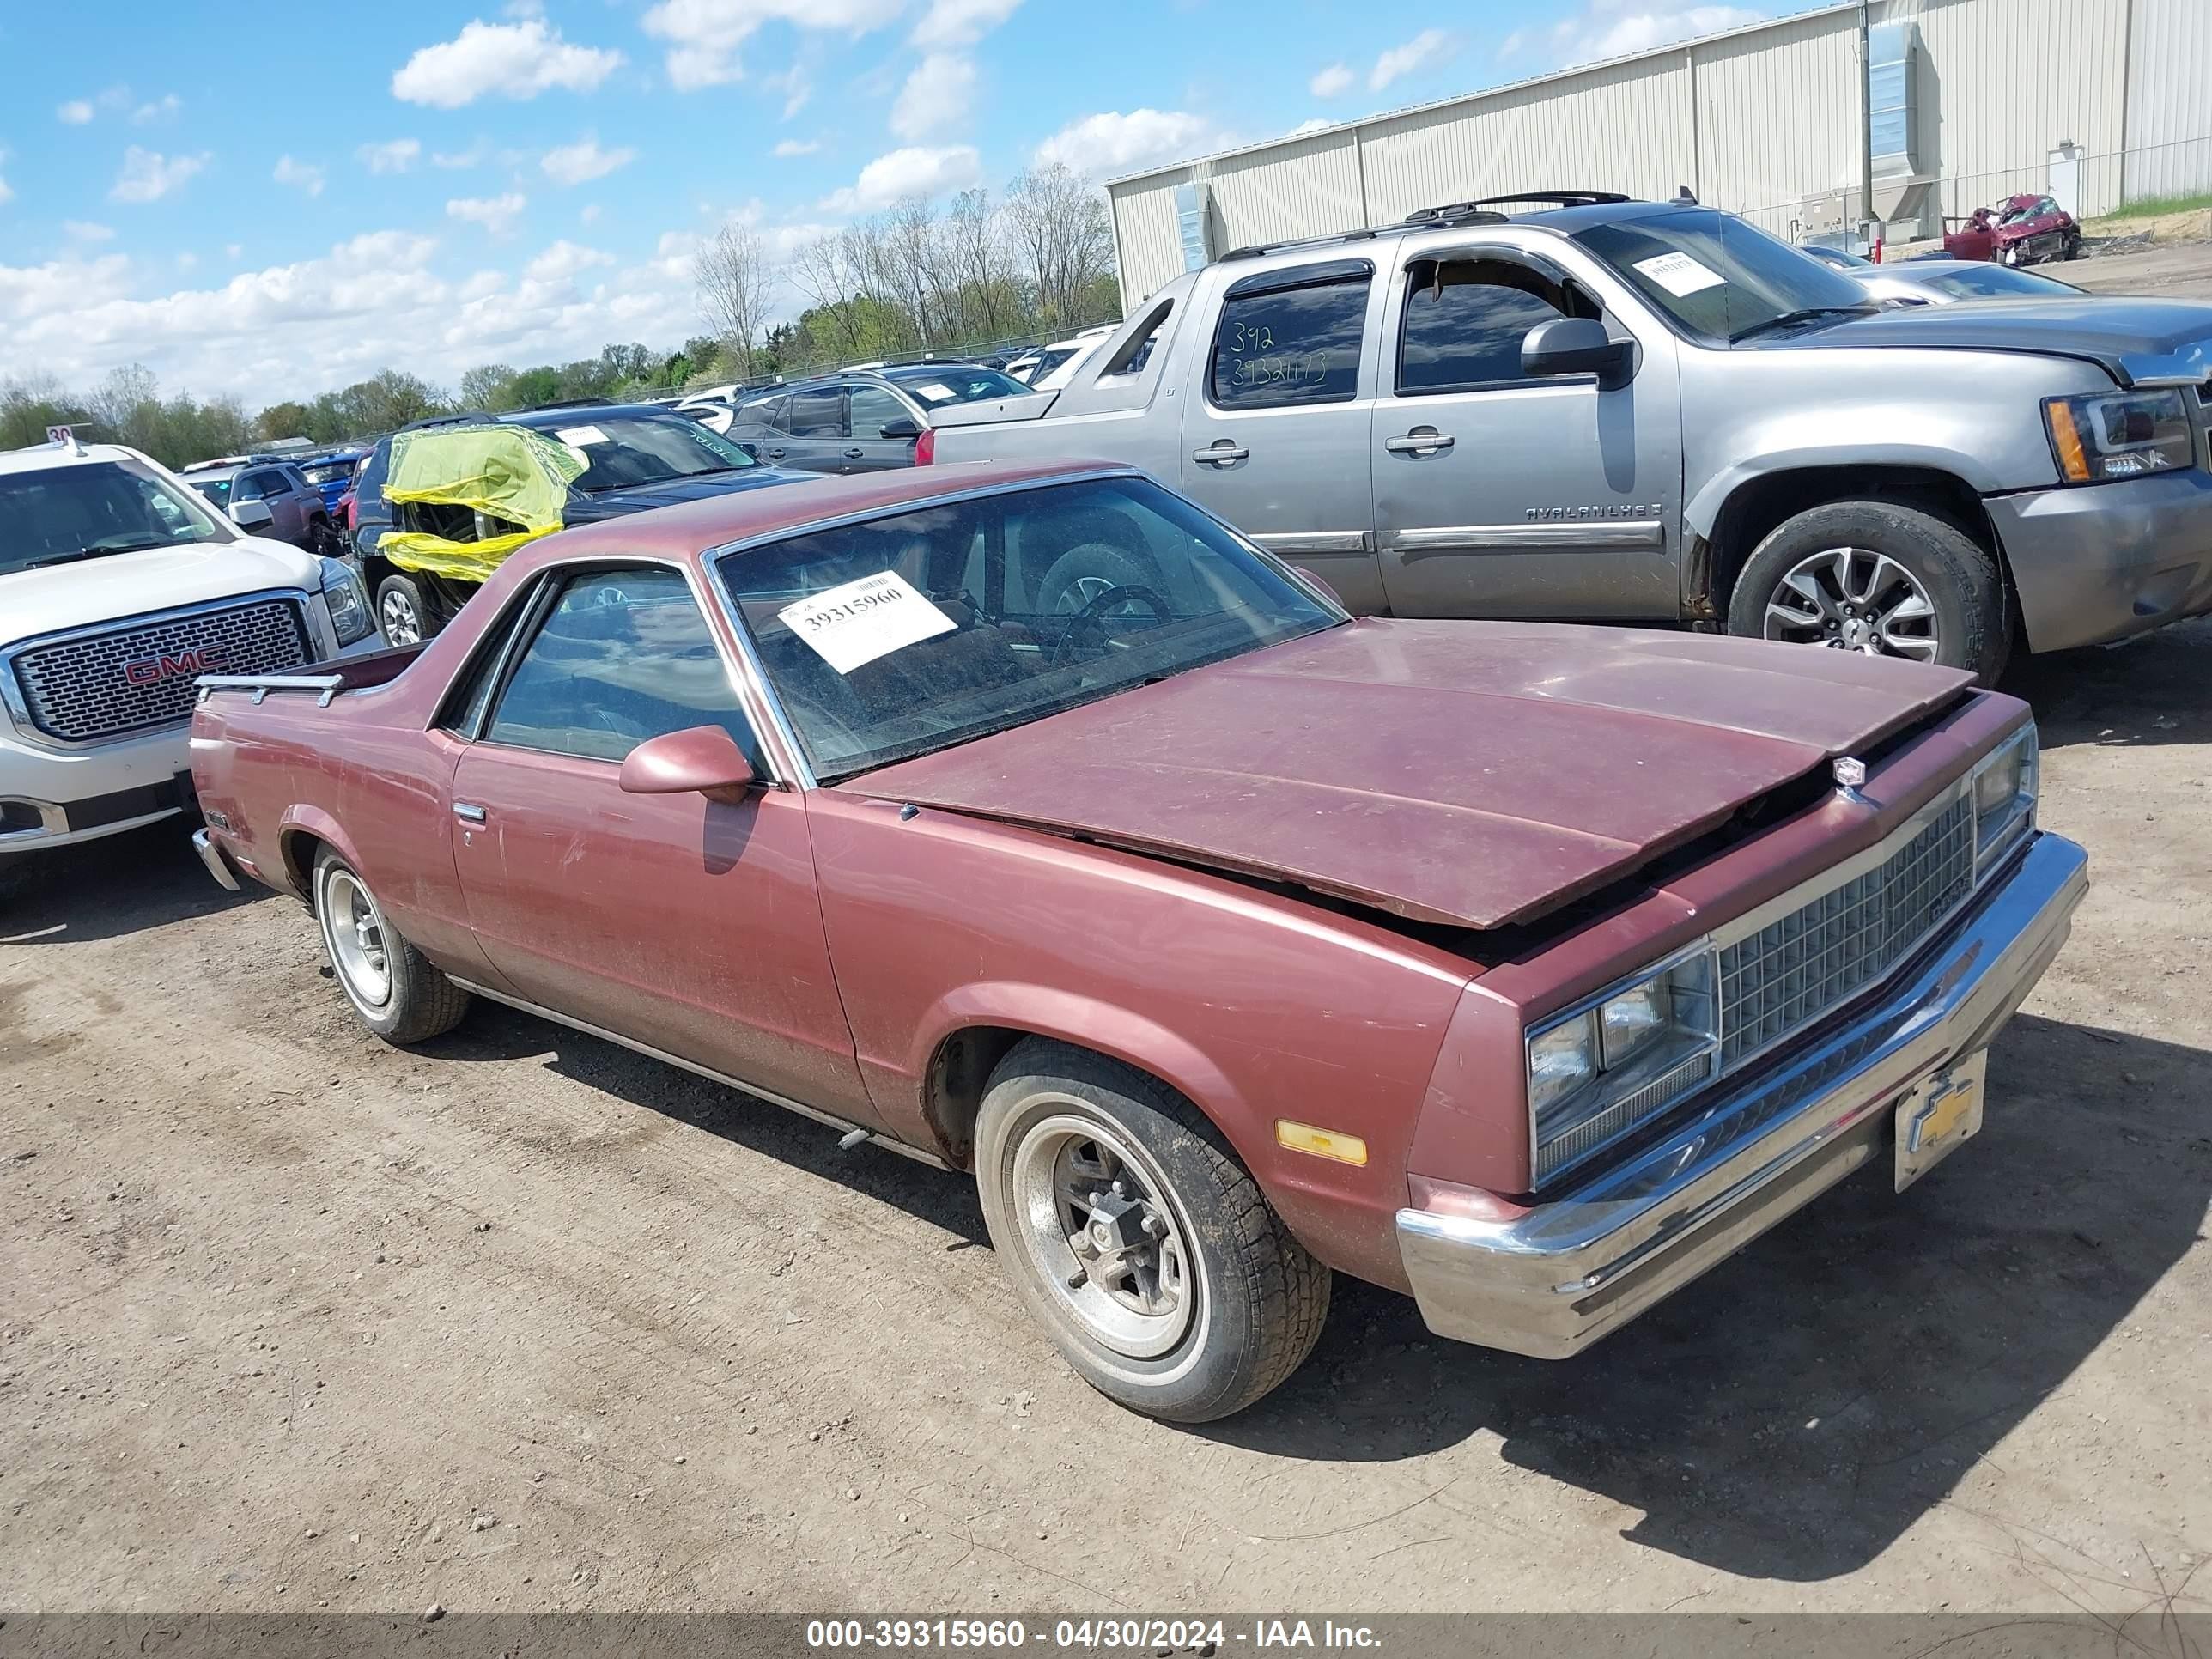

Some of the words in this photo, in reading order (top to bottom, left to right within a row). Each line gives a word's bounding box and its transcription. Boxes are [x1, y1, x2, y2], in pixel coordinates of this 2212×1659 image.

[1230, 322, 1275, 353] 392
[1231, 351, 1327, 386] 39321173
[805, 587, 902, 632] 39315960
[124, 643, 230, 684] GMC
